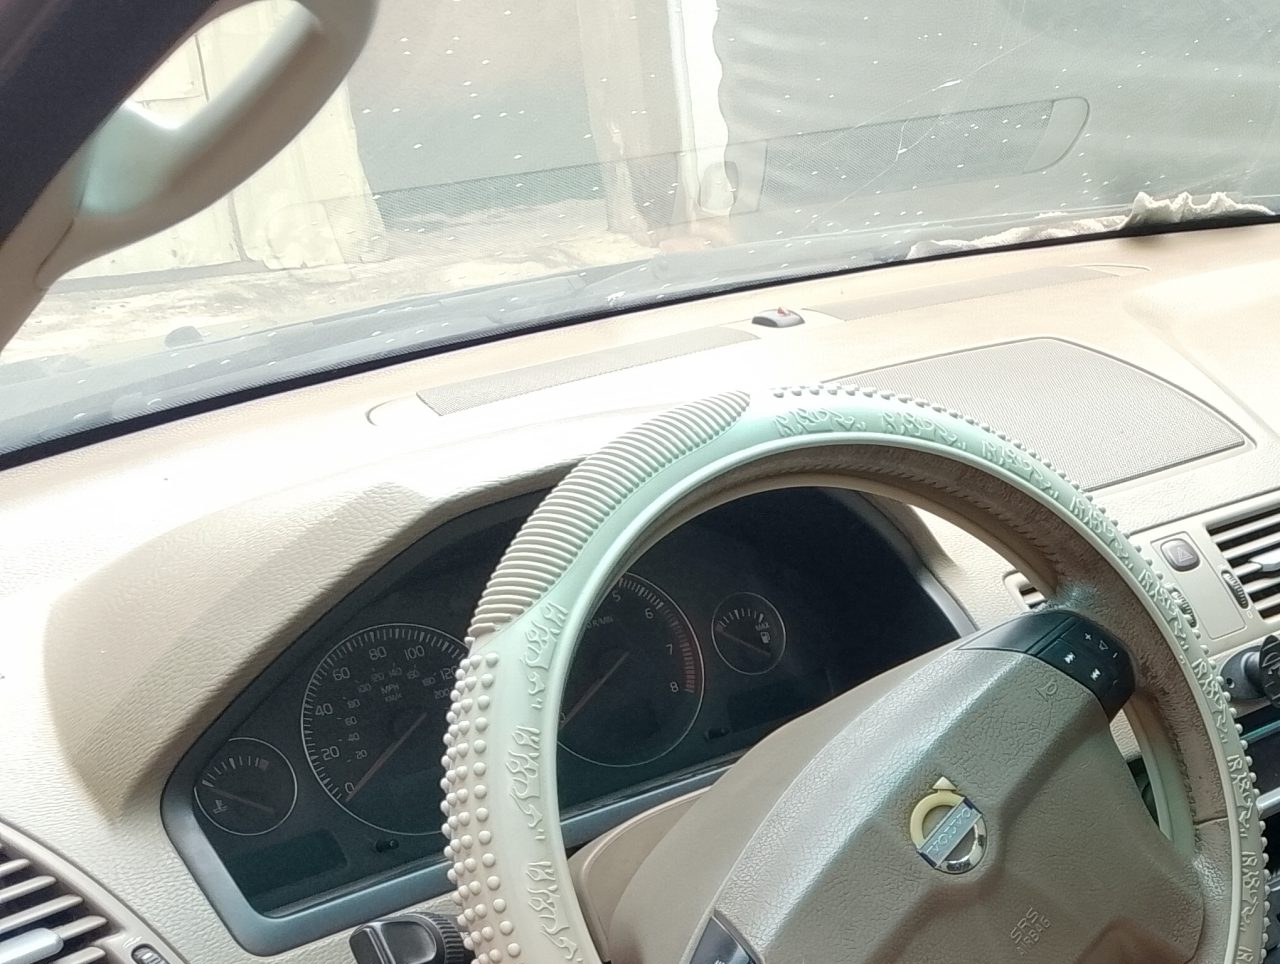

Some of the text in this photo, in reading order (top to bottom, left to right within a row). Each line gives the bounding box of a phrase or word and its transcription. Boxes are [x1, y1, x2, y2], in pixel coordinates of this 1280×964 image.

[612, 591, 621, 602] 5
[644, 607, 654, 619] 6
[368, 646, 387, 660] 80
[404, 645, 425, 661] 100
[665, 643, 674, 655] 7
[332, 667, 351, 681] 60
[380, 683, 400, 694] MPH
[669, 681, 679, 693] 8
[315, 703, 333, 716] 40
[321, 746, 340, 761] 20
[355, 749, 368, 760] 20
[1010, 905, 1040, 944] SRS
